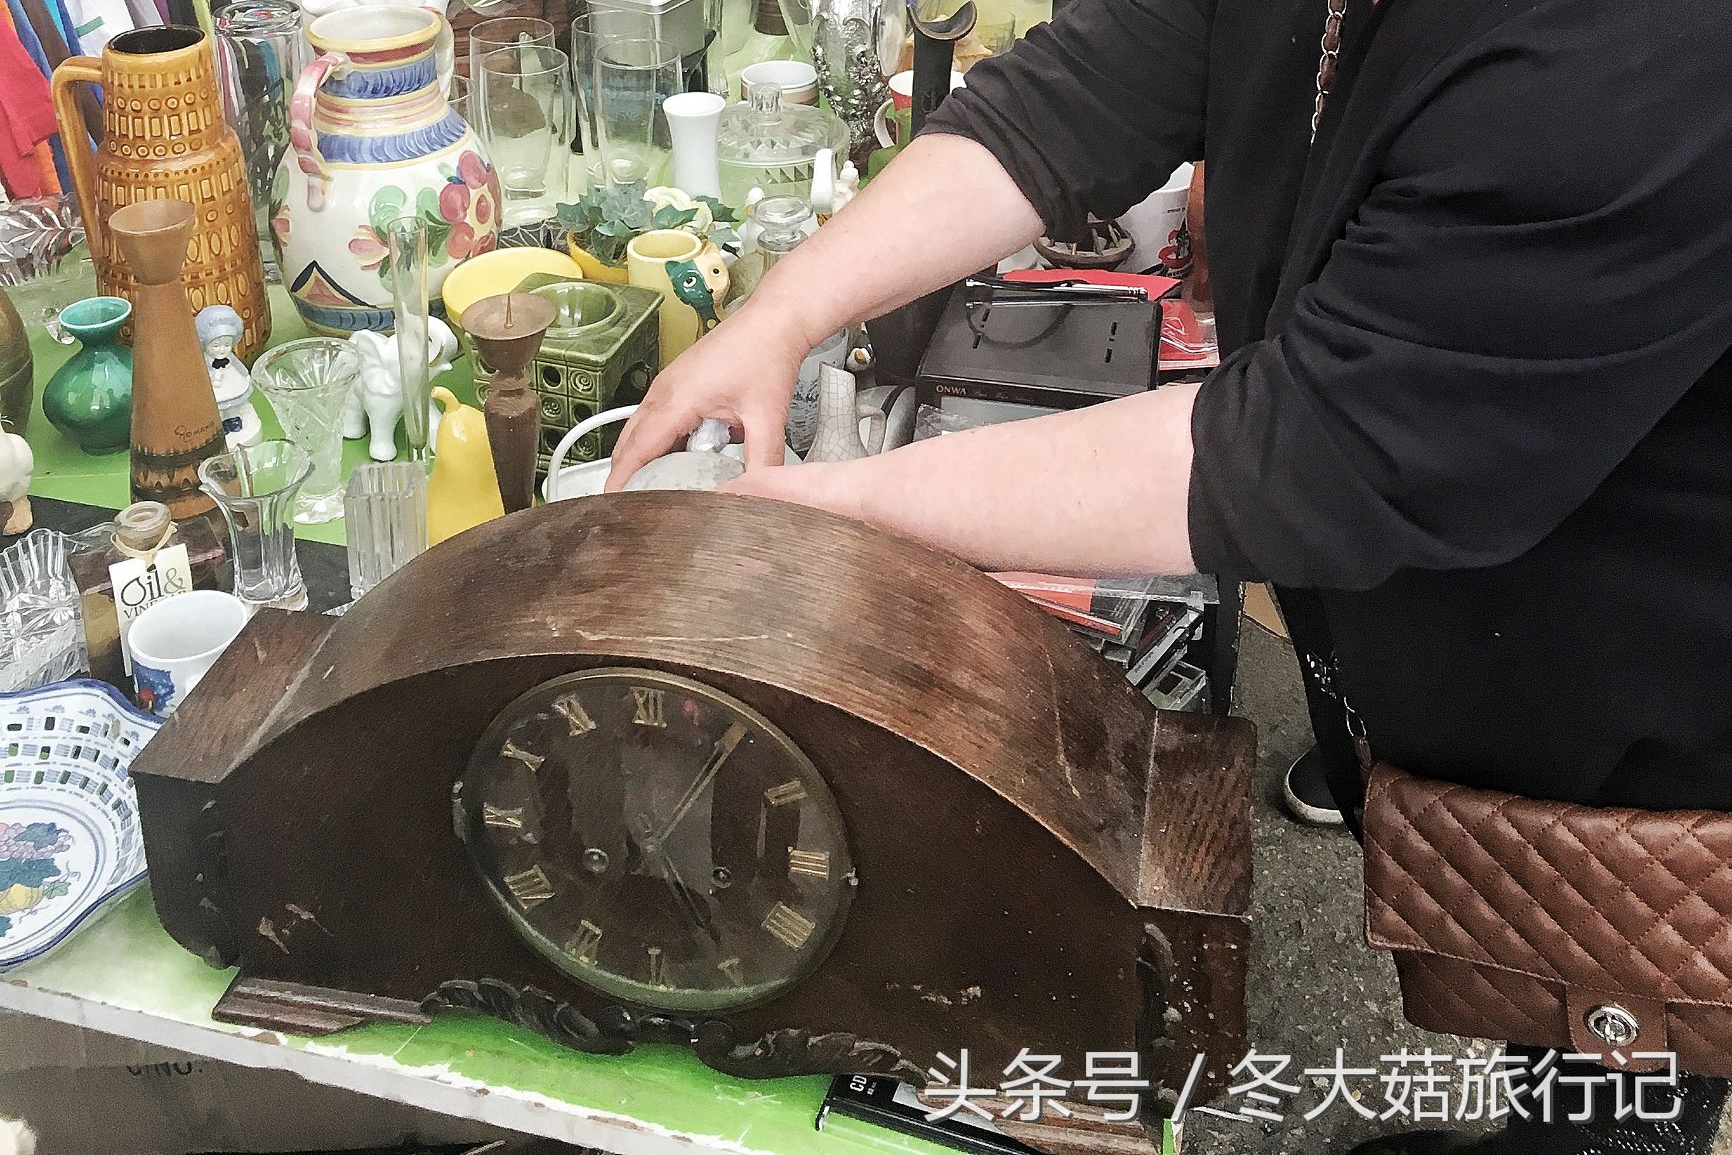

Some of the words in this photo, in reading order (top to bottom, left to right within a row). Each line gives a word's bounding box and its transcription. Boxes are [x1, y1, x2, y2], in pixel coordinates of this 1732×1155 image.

[936, 384, 967, 395] ONWA
[120, 569, 165, 607] Oil
[163, 567, 187, 594] &
[551, 693, 597, 737] XI
[629, 686, 668, 729] XII
[483, 802, 524, 828] IX
[787, 846, 830, 881] III
[849, 1074, 867, 1092] CD
